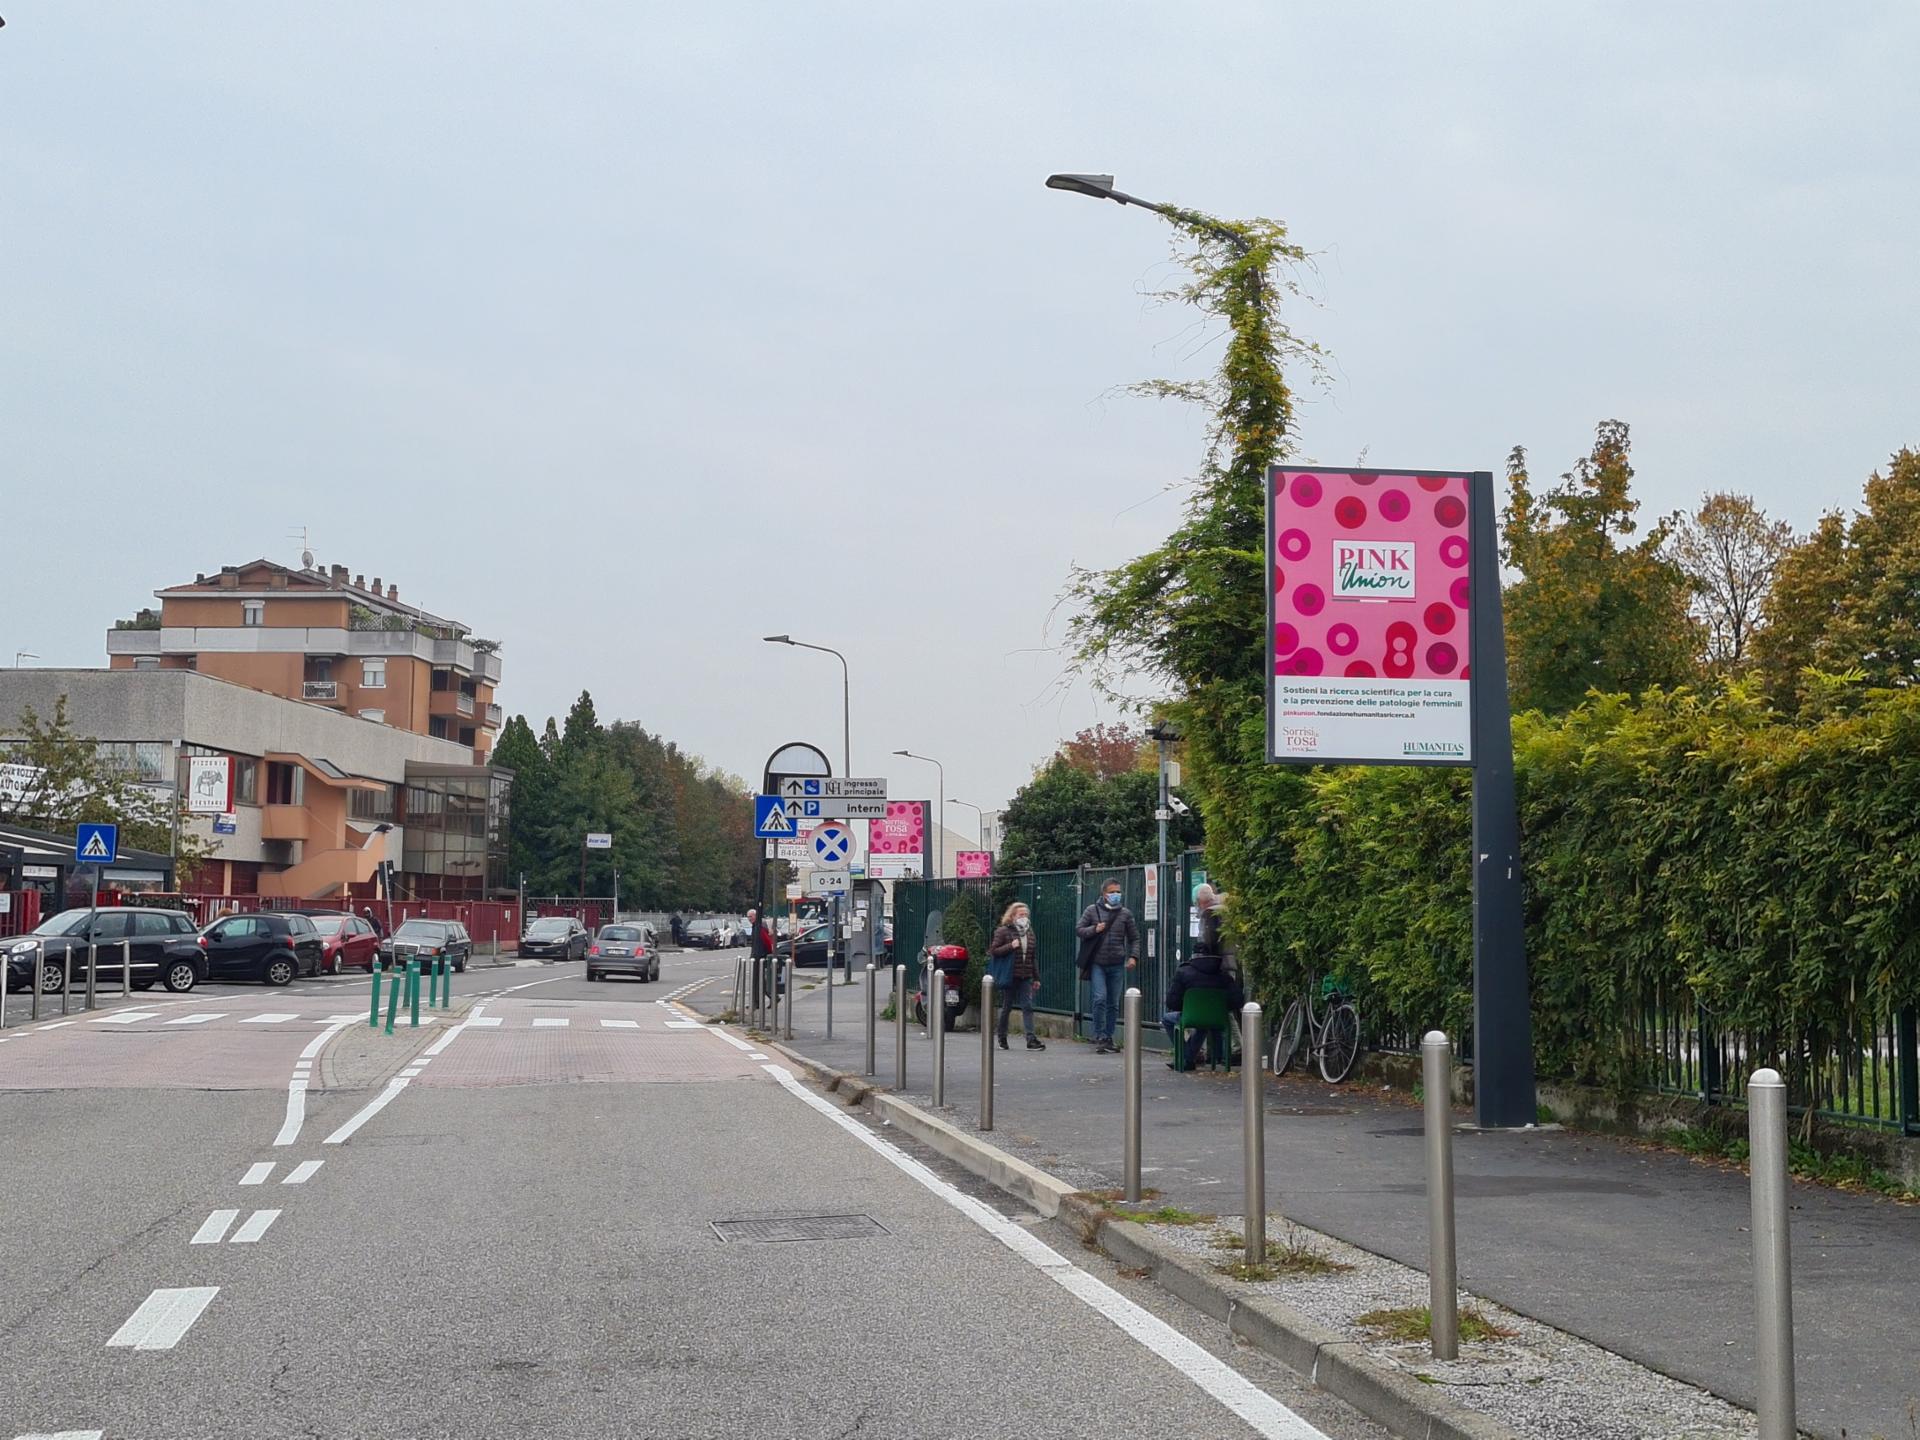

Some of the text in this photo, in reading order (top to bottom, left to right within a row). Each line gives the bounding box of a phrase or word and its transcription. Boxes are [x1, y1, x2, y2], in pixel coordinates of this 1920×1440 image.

[1339, 548, 1411, 570] PINK
[1339, 562, 1410, 591] Union
[1283, 686, 1318, 694] Sostieni
[1329, 687, 1359, 695] ricerca
[1361, 688, 1405, 697] scientifica
[1407, 689, 1422, 698] per
[1300, 697, 1354, 706] prevenzione
[1356, 698, 1377, 706] delle
[1379, 699, 1420, 708] patologie
[1422, 700, 1463, 708] femminili
[1282, 726, 1314, 736] Sorrisi
[1287, 736, 1317, 746] rosa
[1403, 742, 1464, 752] HUMANITAS
[844, 780, 878, 789] ingresso
[844, 787, 884, 796] principale
[847, 803, 884, 813] interni
[885, 824, 907, 833] rosa
